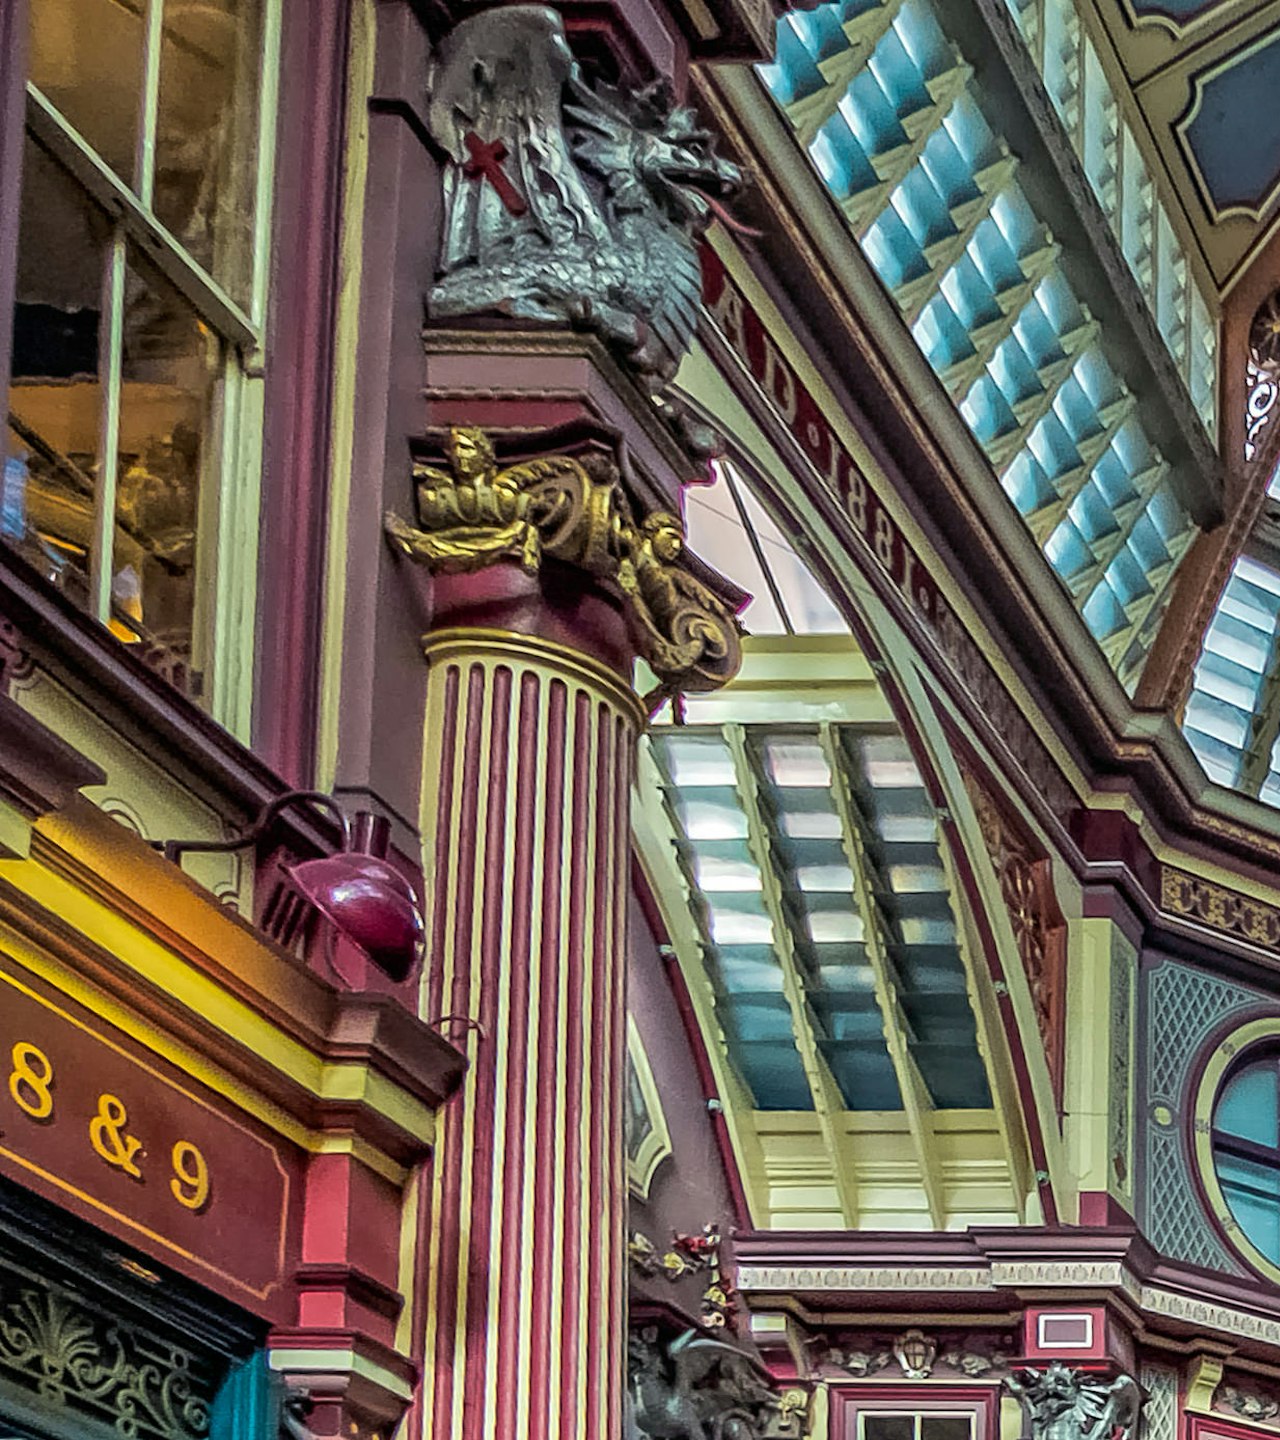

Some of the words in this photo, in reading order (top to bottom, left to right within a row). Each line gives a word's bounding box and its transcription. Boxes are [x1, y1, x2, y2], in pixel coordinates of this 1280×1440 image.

[9, 1041, 52, 1118] 8
[89, 1093, 148, 1178] &
[170, 1140, 208, 1209] 9
